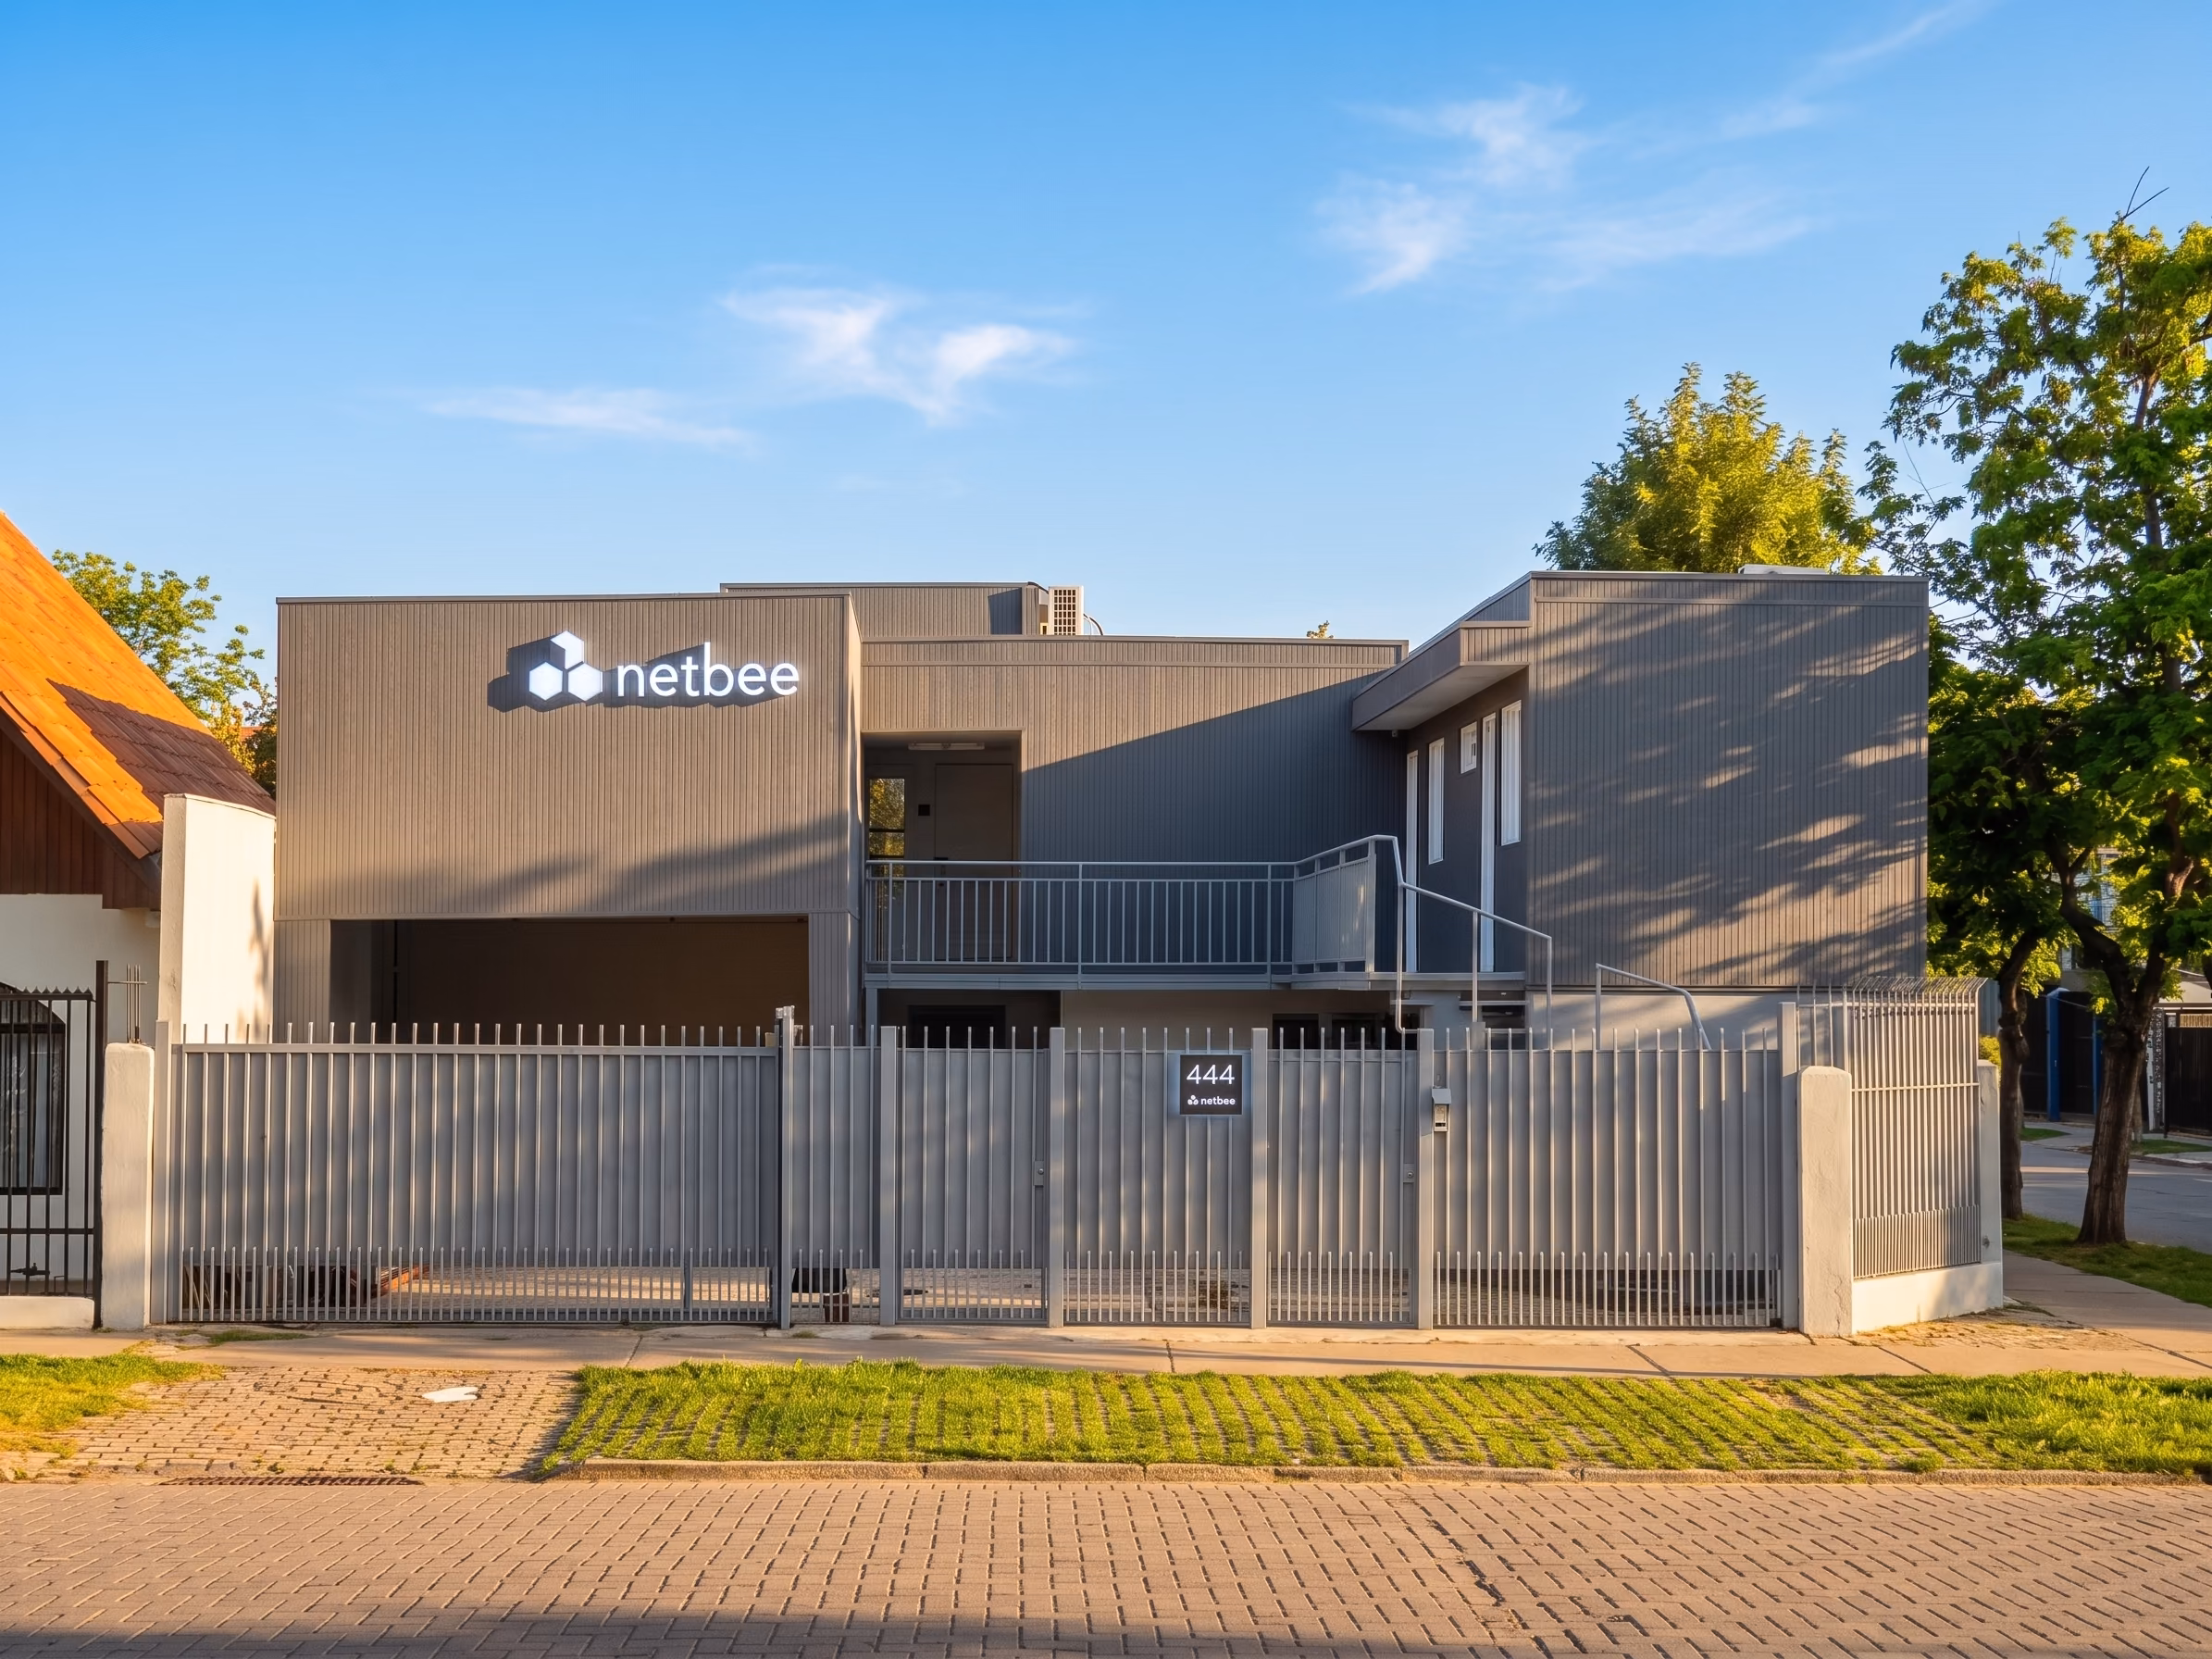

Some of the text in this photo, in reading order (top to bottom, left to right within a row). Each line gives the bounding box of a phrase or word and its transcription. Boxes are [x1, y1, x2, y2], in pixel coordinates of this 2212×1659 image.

[617, 642, 800, 697] netbee
[1187, 1065, 1235, 1084] 444
[1201, 1096, 1236, 1105] netbee
